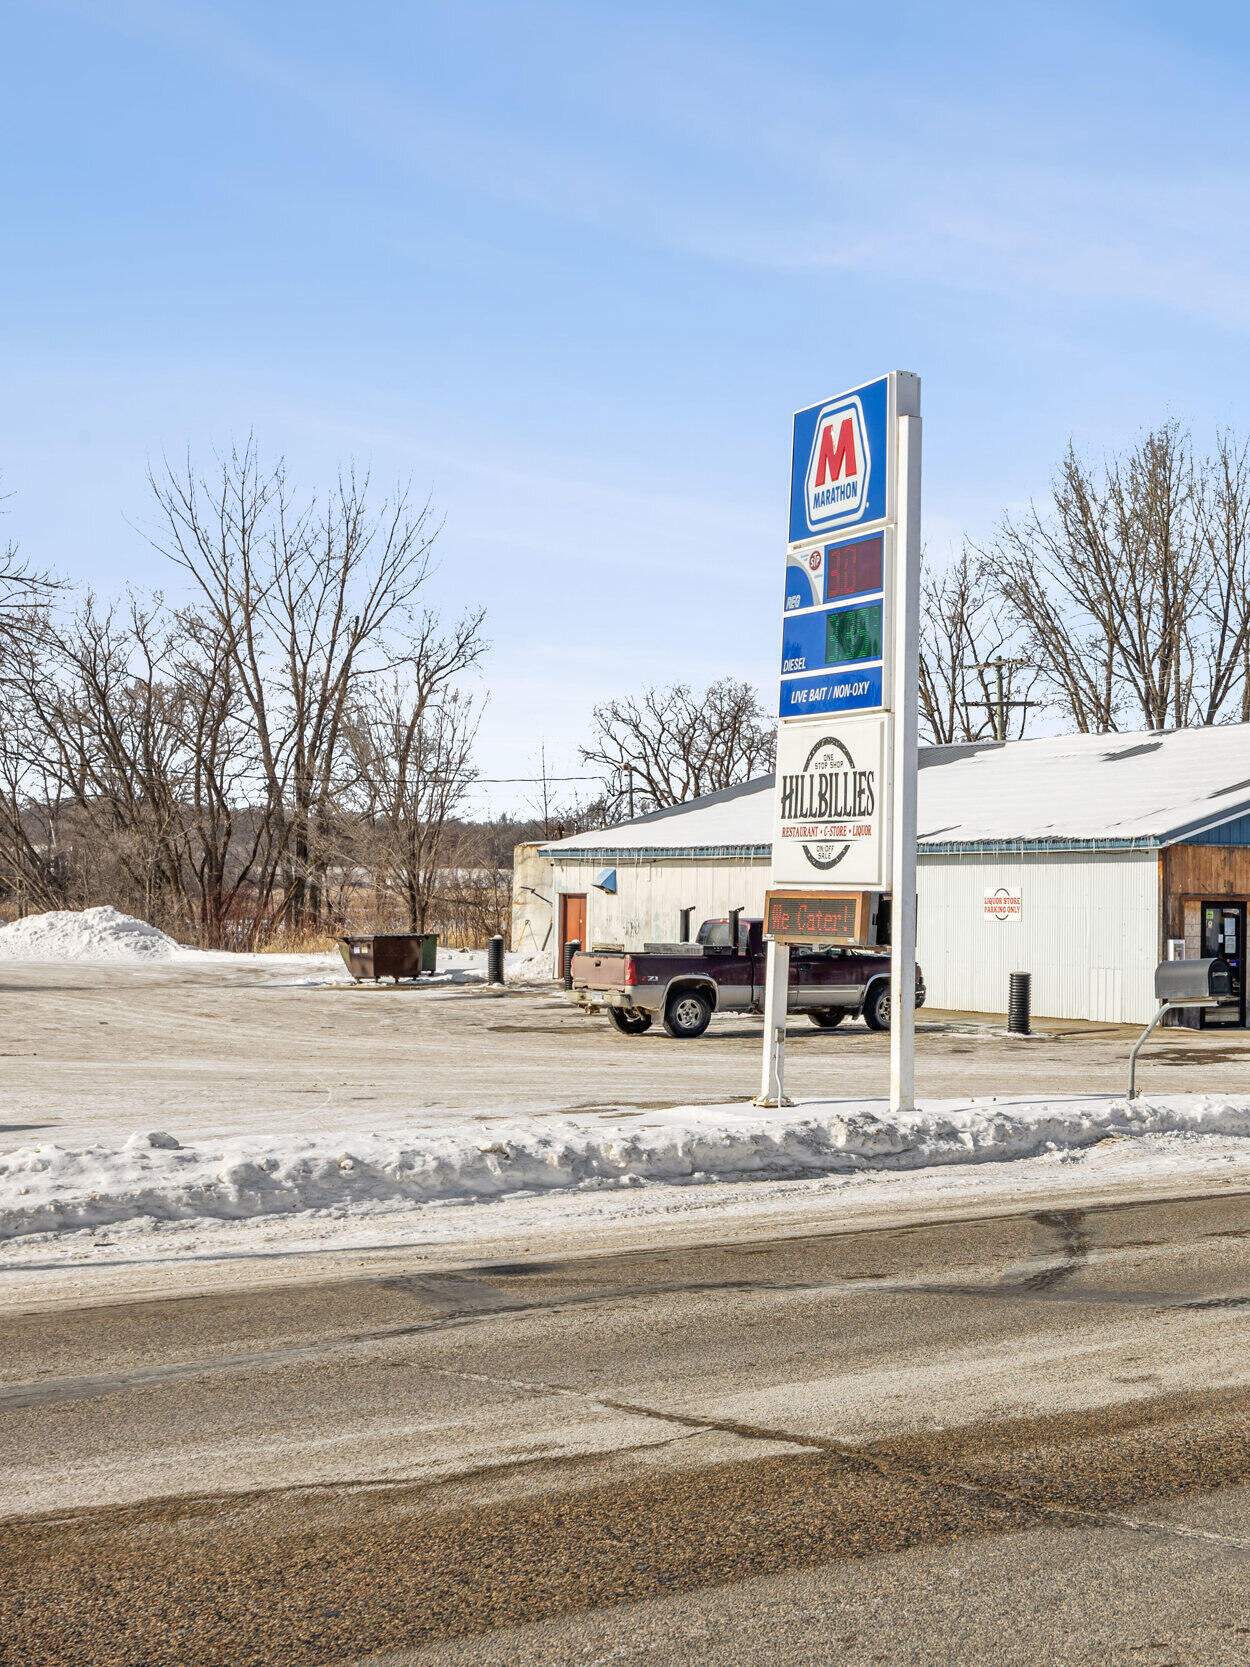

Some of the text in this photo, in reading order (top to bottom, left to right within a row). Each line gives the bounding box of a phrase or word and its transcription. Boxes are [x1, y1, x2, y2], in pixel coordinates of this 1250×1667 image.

[815, 417, 857, 488] M
[813, 480, 858, 510] MARATHON
[783, 657, 807, 672] DIESEL
[791, 690, 808, 704] LIVE
[809, 687, 827, 701] BAIT
[833, 681, 871, 699] NON-OXY
[823, 753, 834, 762] ONE
[814, 760, 844, 770] STOP SHOP
[780, 770, 875, 820] HILLBILLIES
[782, 824, 872, 838] RESTAURANT C-STORE LIQUOR
[818, 852, 832, 860] SALE
[984, 897, 1020, 905] LIQUOR STORE
[984, 906, 1020, 914] PARKING ONLY
[772, 904, 849, 932] We Cater!
